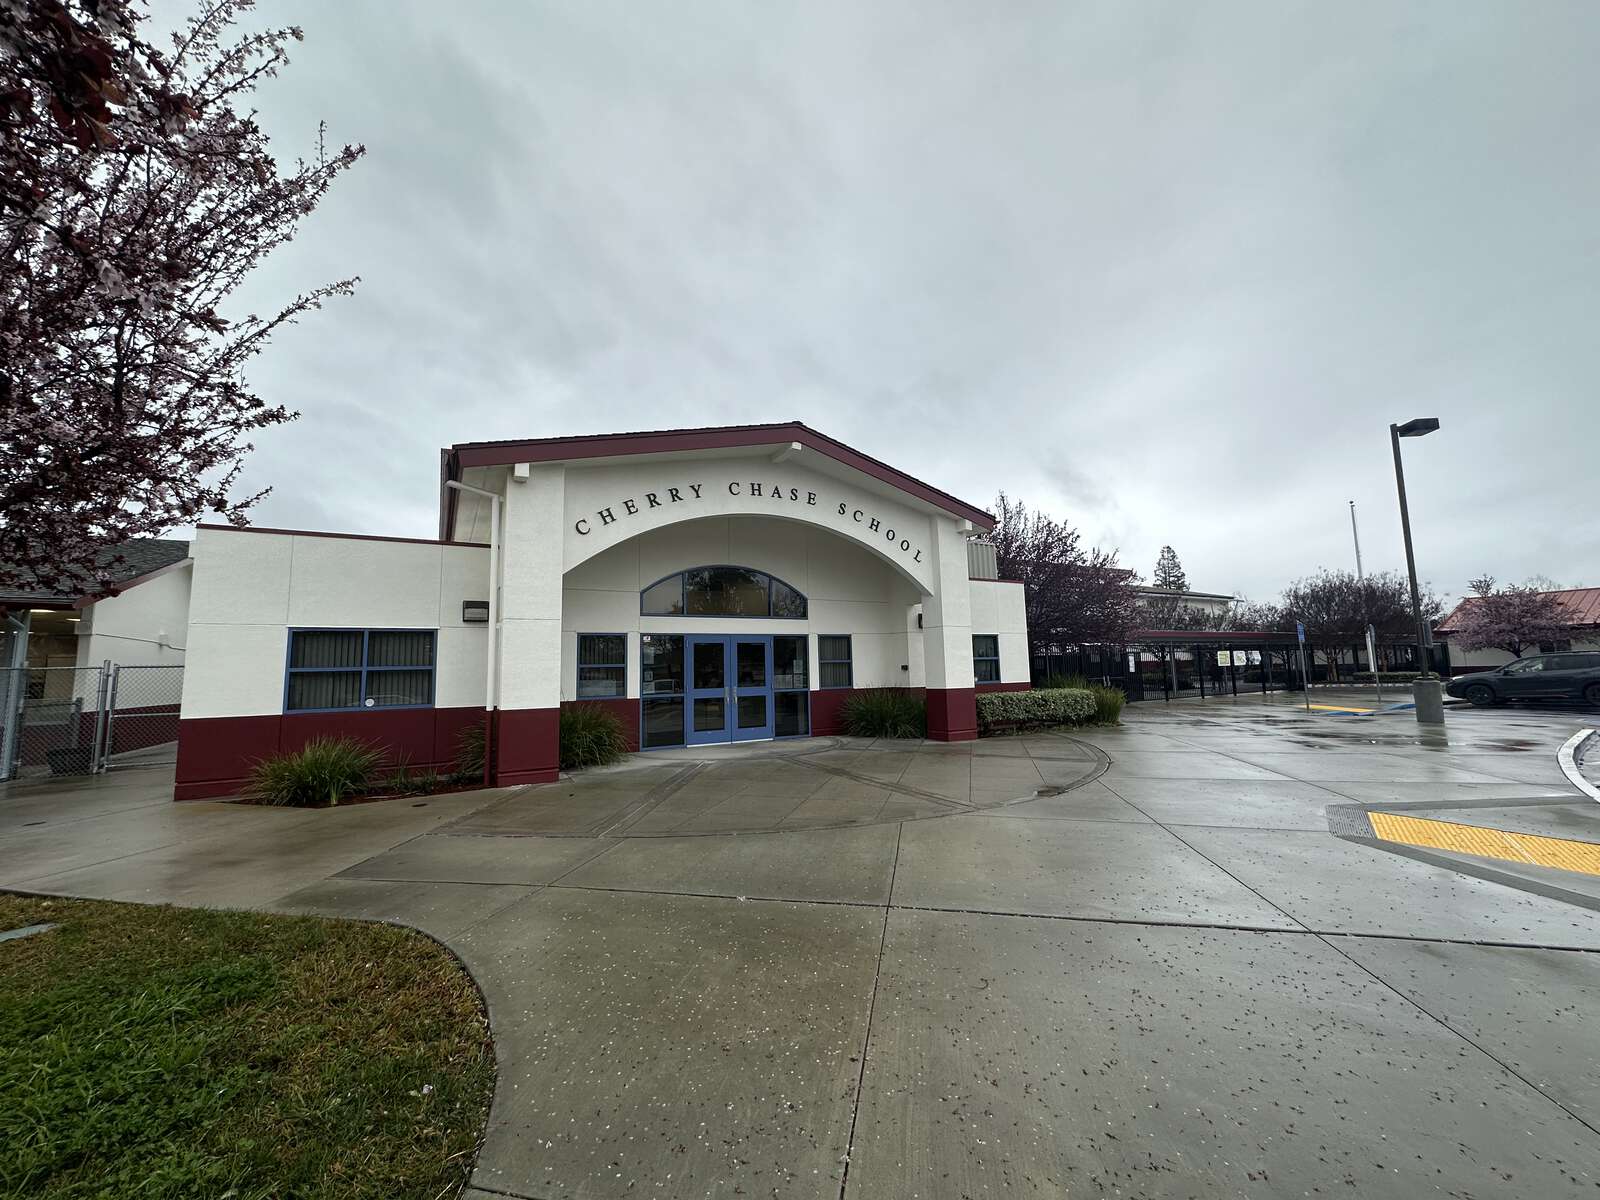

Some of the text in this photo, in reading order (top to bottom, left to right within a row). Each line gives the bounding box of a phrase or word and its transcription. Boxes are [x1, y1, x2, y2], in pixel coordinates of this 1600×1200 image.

[575, 482, 923, 563] CHERRY CHASE SCHOOL
